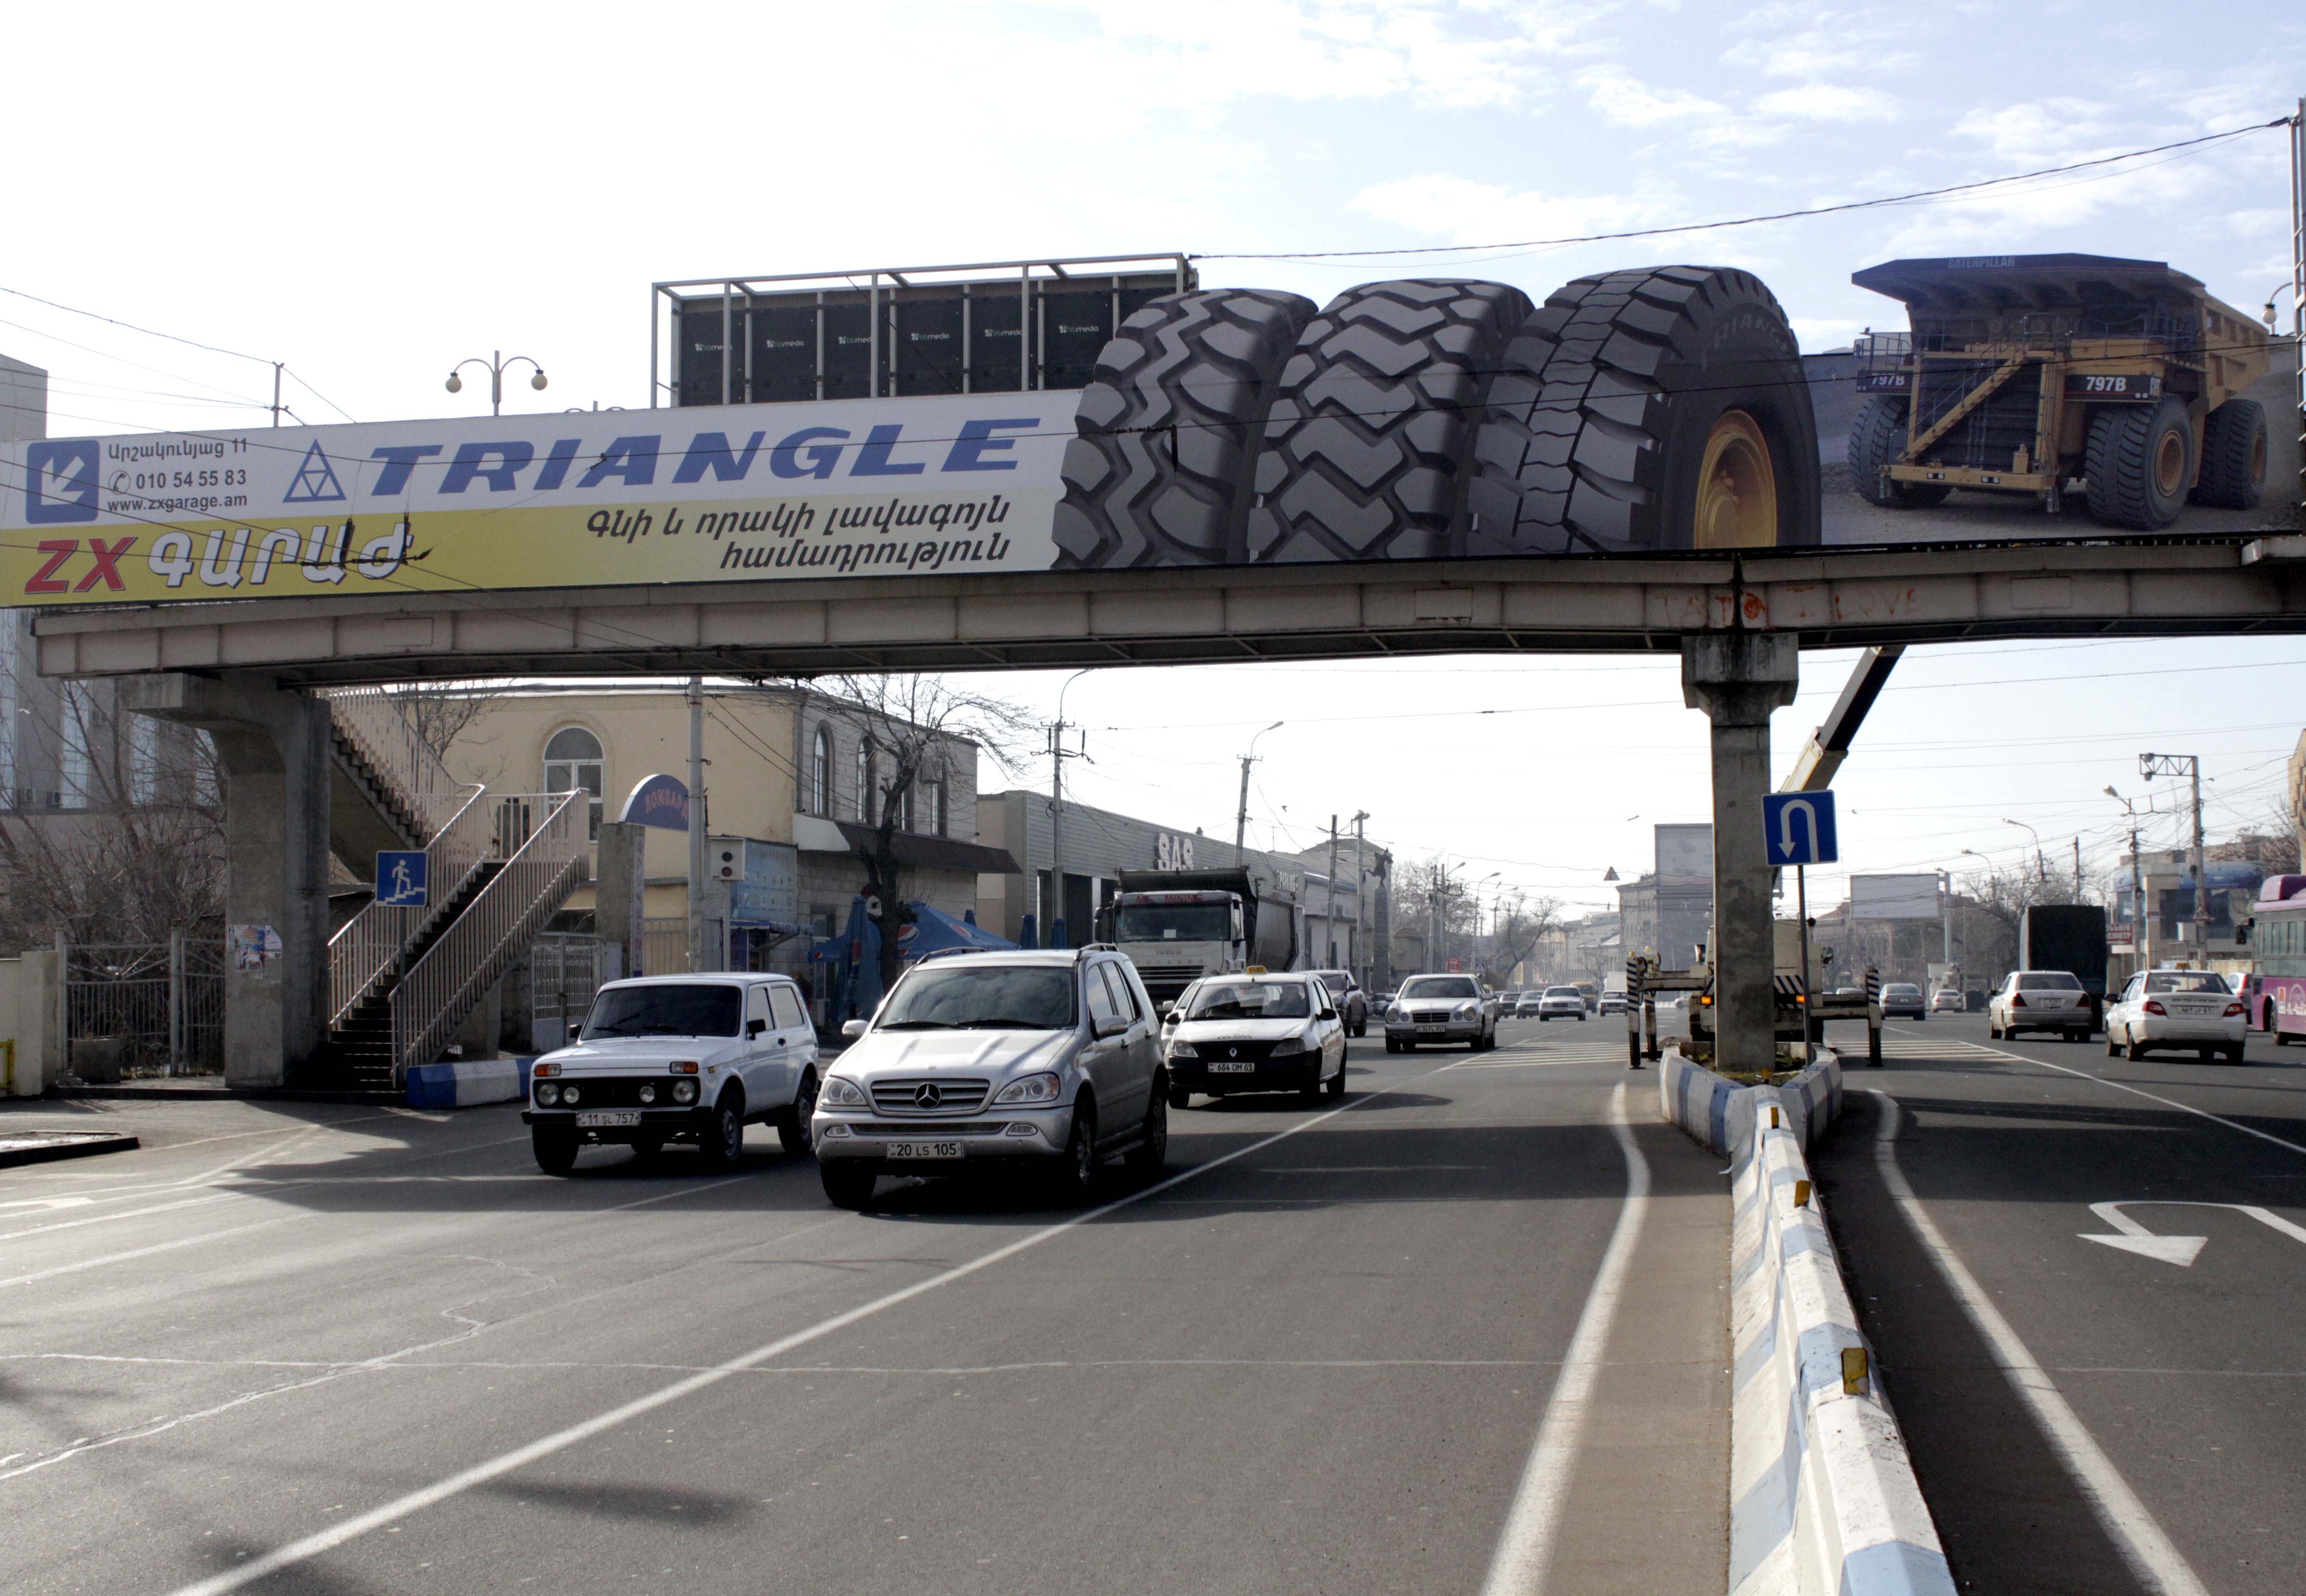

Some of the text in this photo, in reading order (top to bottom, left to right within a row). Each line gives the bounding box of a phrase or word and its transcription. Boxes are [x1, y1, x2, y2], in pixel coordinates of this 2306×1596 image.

[1948, 256, 2015, 269] CATERPILLAR
[1871, 373, 1905, 386] 797B
[2086, 376, 2127, 392] 797B
[108, 437, 247, 462] Արշակունյաց 11
[370, 417, 1041, 496] TRIANGLE
[136, 472, 167, 490] 010
[173, 471, 194, 488] 54
[198, 470, 219, 487] 55
[107, 494, 248, 513] www.zxgarage.am
[587, 508, 653, 544] Գնի
[695, 502, 816, 541] որակի
[720, 532, 1011, 573] համադրություն
[24, 536, 139, 595] ZX
[1158, 833, 1194, 871] SAS
[1164, 894, 1204, 903] MINING
[588, 1113, 635, 1124] 11 SL 757
[897, 1143, 957, 1156] 20 LS 105
